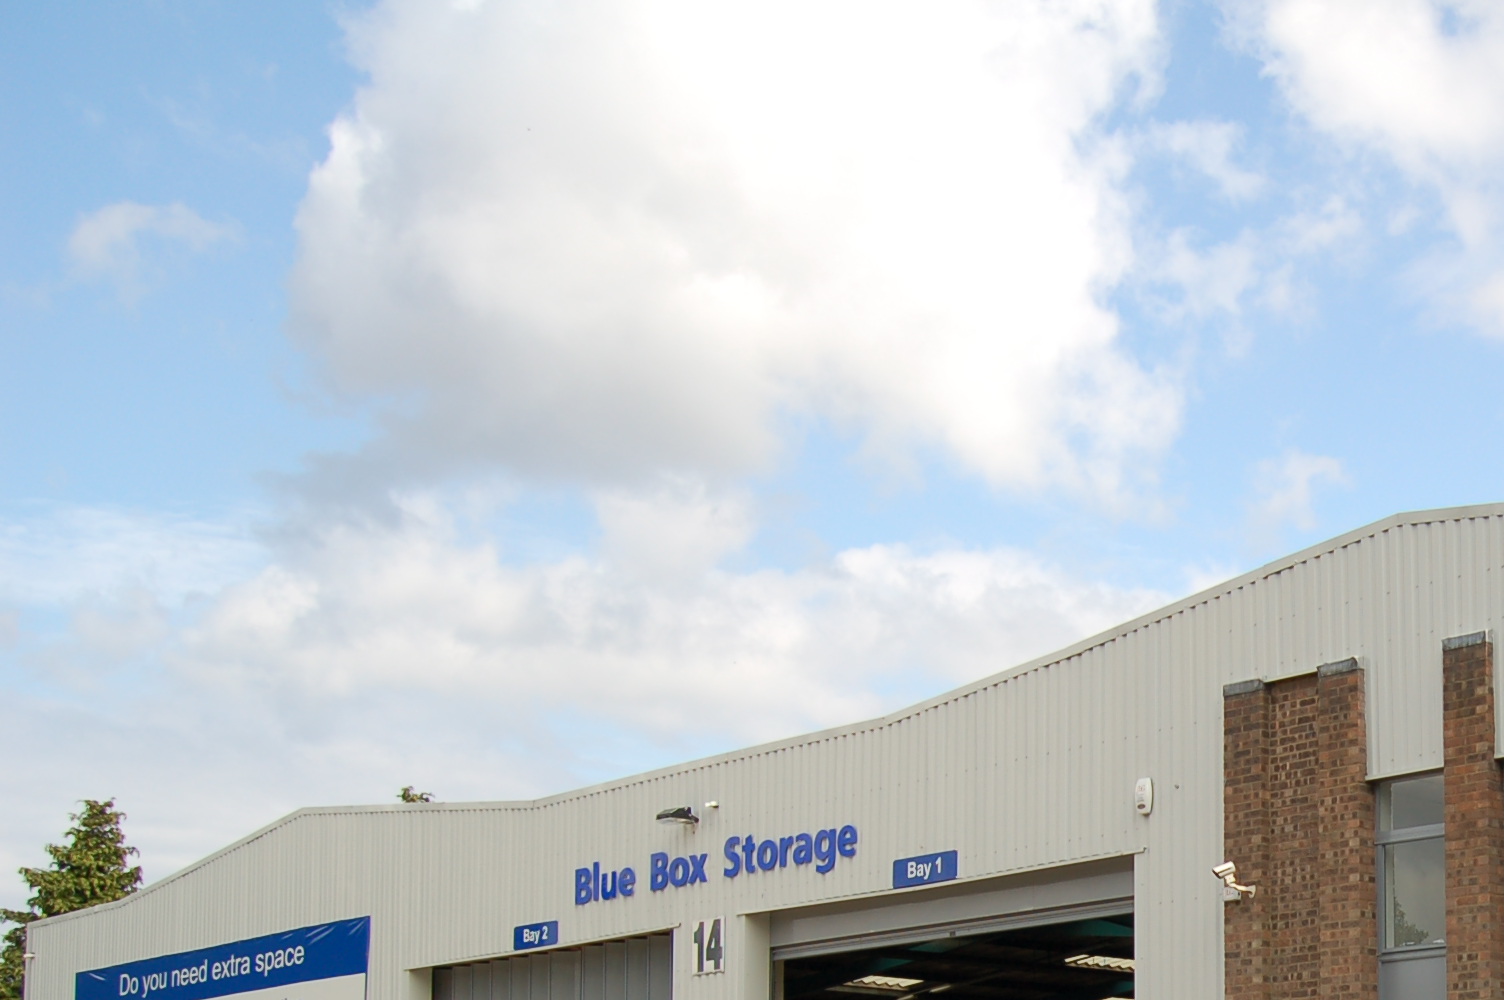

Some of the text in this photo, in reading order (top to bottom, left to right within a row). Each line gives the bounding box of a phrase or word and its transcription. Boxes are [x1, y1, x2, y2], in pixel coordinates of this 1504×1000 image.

[575, 824, 858, 905] Blue Box Storage
[906, 857, 943, 881] Bay 1
[522, 926, 549, 944] Bay 2
[693, 918, 724, 974] 14
[119, 945, 305, 998] Do you need extra space
